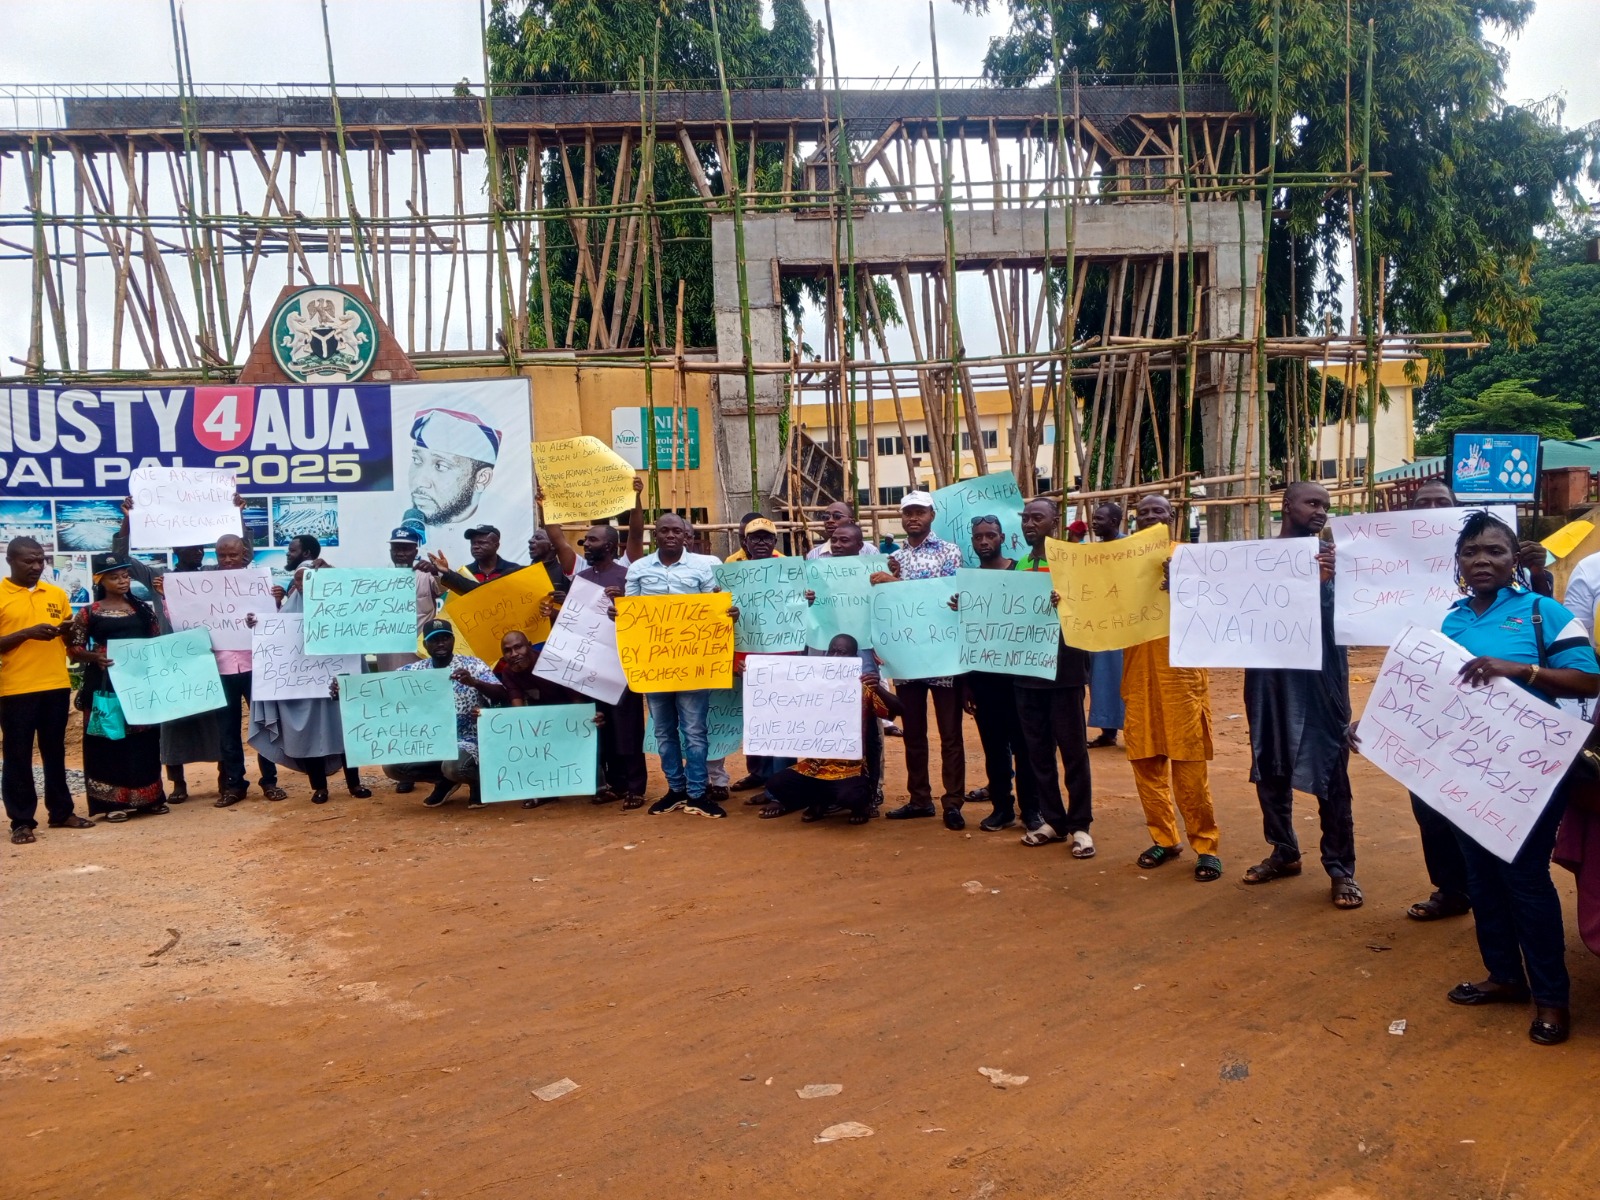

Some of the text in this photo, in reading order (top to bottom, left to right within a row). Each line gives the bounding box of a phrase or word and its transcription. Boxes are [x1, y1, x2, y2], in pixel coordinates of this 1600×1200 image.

[203, 395, 242, 441] 4
[250, 388, 370, 451] AUA
[656, 446, 686, 454] Cenre
[133, 470, 157, 482] WE
[169, 469, 204, 485] ARE
[214, 454, 362, 485] 2025
[137, 486, 167, 507] OF
[953, 482, 1019, 510] TEACHERS
[1345, 521, 1398, 542] WE
[1048, 546, 1078, 567] STOP
[1176, 543, 1319, 578] NO TEACH
[1345, 556, 1453, 582] FROM TH
[714, 563, 804, 591] RESPECT LEA
[823, 562, 861, 581] ALERT
[176, 576, 273, 598] NO ALERT
[309, 575, 417, 601] LEA TEACHERS
[1176, 577, 1290, 609] ERS NO
[209, 602, 236, 616] NO
[311, 602, 350, 620] ARE
[350, 598, 382, 615] NOT
[460, 591, 534, 634] Enough is
[731, 588, 784, 612] EACHERS
[813, 592, 870, 609] SUMPTION
[873, 592, 928, 628] GIVE
[959, 590, 993, 624] PAY
[1002, 593, 1026, 615] US
[1347, 585, 1462, 616] SAME MAR
[182, 618, 247, 631] RESUMPT
[253, 617, 287, 636] LEA
[616, 601, 711, 632] SANITIZE
[751, 612, 768, 626] US
[776, 610, 804, 627] OUR
[1062, 602, 1164, 632] TEACHERS
[305, 620, 330, 644] WE
[334, 621, 370, 638] HAVE
[538, 599, 584, 673] WE ARE
[645, 621, 733, 644] THE SYSTEM
[879, 626, 920, 646] OUR
[1177, 609, 1313, 655] NATION
[119, 640, 198, 667] JUSTICE
[252, 642, 285, 661] ARE
[562, 621, 601, 686] FEDERAL
[621, 640, 730, 665] BY PAYING LEA
[959, 644, 977, 666] WE
[979, 648, 1002, 667] ARE
[1003, 649, 1025, 667] NOT
[1393, 625, 1447, 676] LEA
[143, 662, 187, 685] FOR
[263, 657, 344, 681] BEGGARS
[623, 660, 734, 682] TEACHERS IN FCT
[747, 660, 780, 687] LET
[786, 661, 816, 681] LEA
[120, 680, 220, 711] TEACHERS
[344, 675, 437, 702] LET THE
[752, 689, 825, 714] BREATHE
[829, 688, 857, 712] PLS
[363, 701, 410, 720] LEA
[1378, 686, 1454, 750] DAILY
[1383, 660, 1563, 776] ARE DYING ON
[347, 722, 442, 742] TEACHERS
[490, 713, 592, 741] GIVE US
[706, 718, 743, 737] DEMAN
[748, 716, 848, 737] GIVE US OUR
[371, 738, 435, 760] BREATHE
[507, 742, 559, 763] OUR
[1371, 715, 1442, 779] TREAT
[1439, 778, 1470, 804] US
[497, 763, 583, 792] RIGHTS
